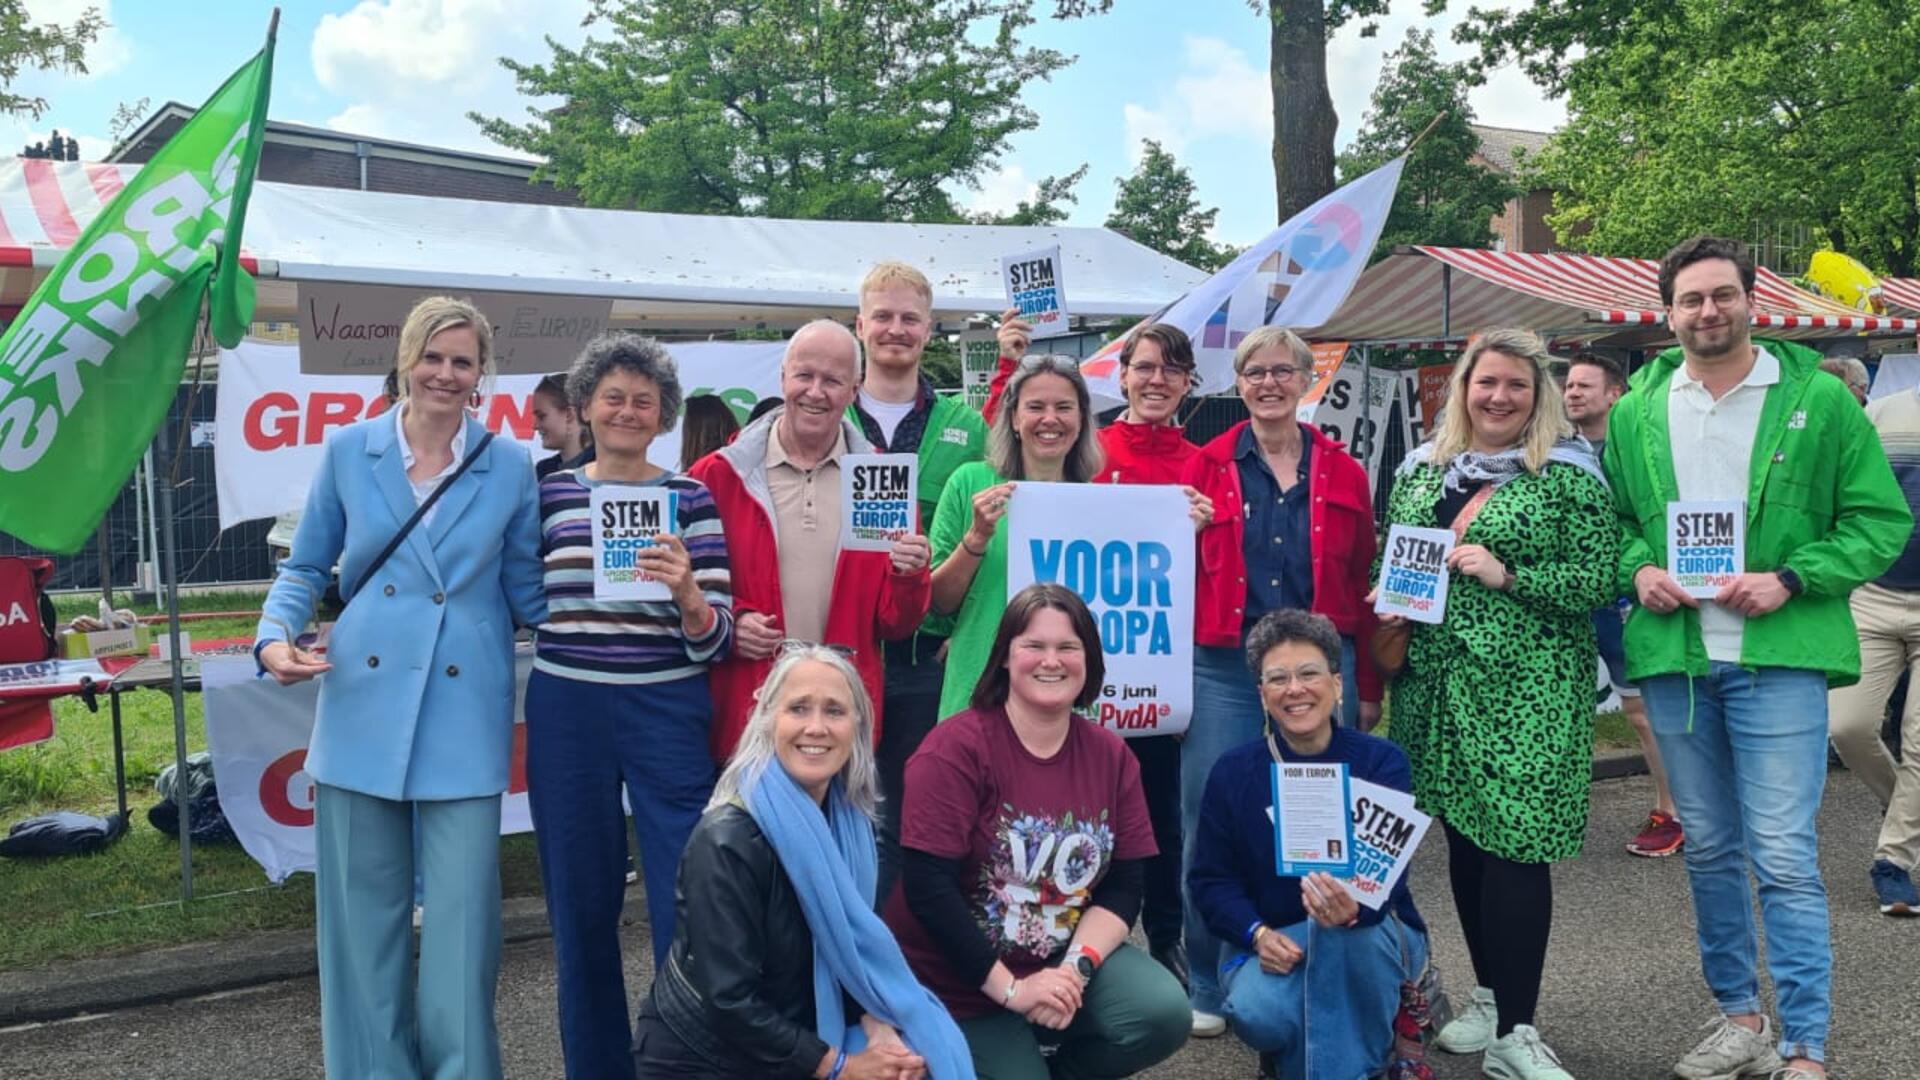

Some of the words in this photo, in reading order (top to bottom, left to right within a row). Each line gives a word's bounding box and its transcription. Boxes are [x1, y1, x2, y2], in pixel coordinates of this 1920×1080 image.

[1010, 257, 1054, 285] STEM
[1013, 288, 1056, 300] VOOR
[1023, 280, 1055, 291] JUNI
[967, 384, 991, 395] VOO
[853, 465, 909, 491] STEM
[852, 492, 864, 500] 6
[867, 491, 908, 500] JUNI
[601, 500, 660, 528] STEM
[853, 501, 908, 511] VOOR
[852, 511, 908, 528] EUROPA
[1676, 512, 1734, 538] STEM
[602, 529, 614, 539] 6
[618, 529, 660, 538] JUNI
[1676, 538, 1688, 547] 6
[1692, 538, 1734, 547] JUNI
[1393, 535, 1446, 567] STEM
[1677, 547, 1735, 556] VOOR
[1029, 538, 1172, 607] VOOR
[1404, 562, 1440, 575] JUNI
[1677, 557, 1735, 573] EUROPA
[1390, 566, 1438, 584] VOOR
[1385, 575, 1435, 600] EUROPA
[1091, 610, 1171, 655] OPA
[1103, 684, 1116, 698] 6
[1123, 684, 1157, 701] juni
[1100, 703, 1158, 729] PvdA
[1283, 767, 1304, 778] VOOR
[1306, 767, 1337, 779] EUROPA
[1352, 797, 1417, 849] STEM
[1358, 833, 1401, 858] JUNI
[1353, 840, 1397, 869] OOR
